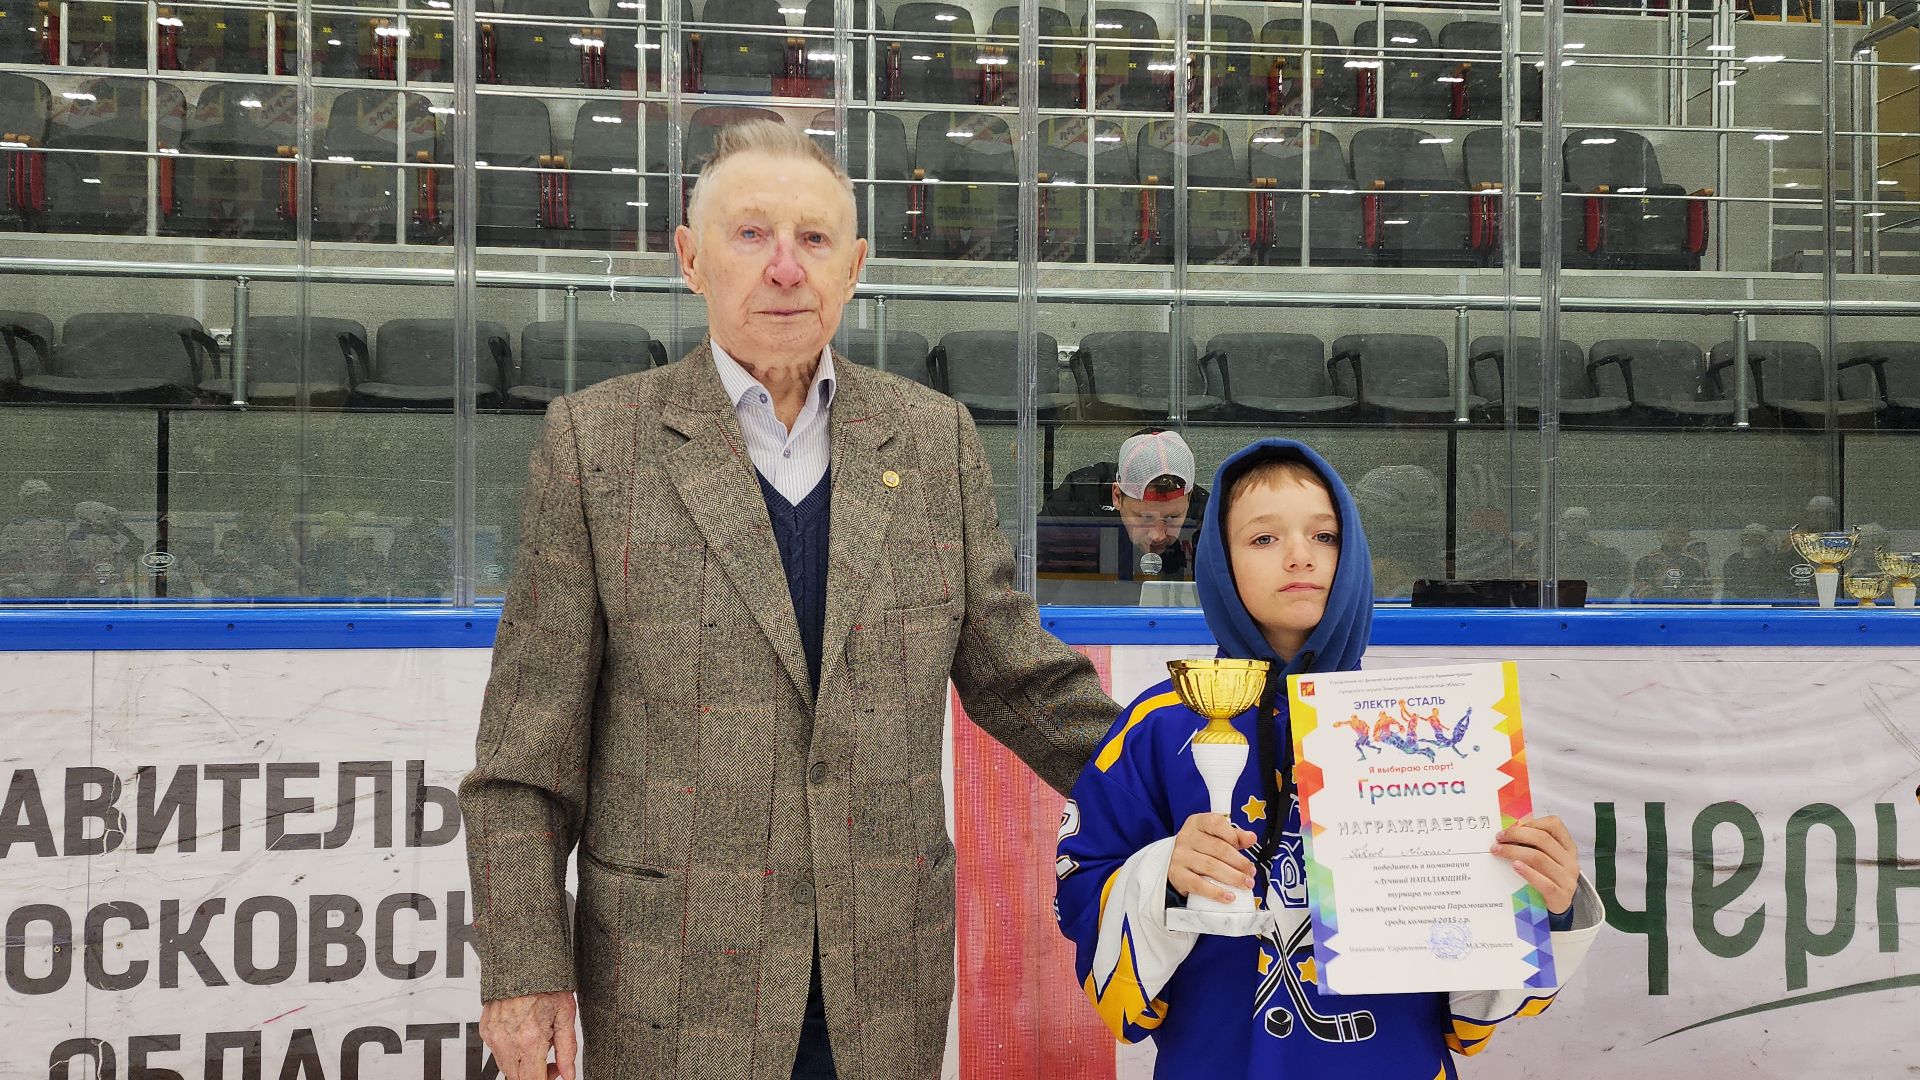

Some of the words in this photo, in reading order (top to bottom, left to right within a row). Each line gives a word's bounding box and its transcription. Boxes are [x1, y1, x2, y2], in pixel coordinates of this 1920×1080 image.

[1368, 766, 1375, 774] Я
[1377, 765, 1421, 774] выбираю
[1423, 762, 1454, 773] спорт!
[1358, 779, 1466, 805] Грамота
[1338, 815, 1491, 836] НАГРАЖДАЕТСЯ
